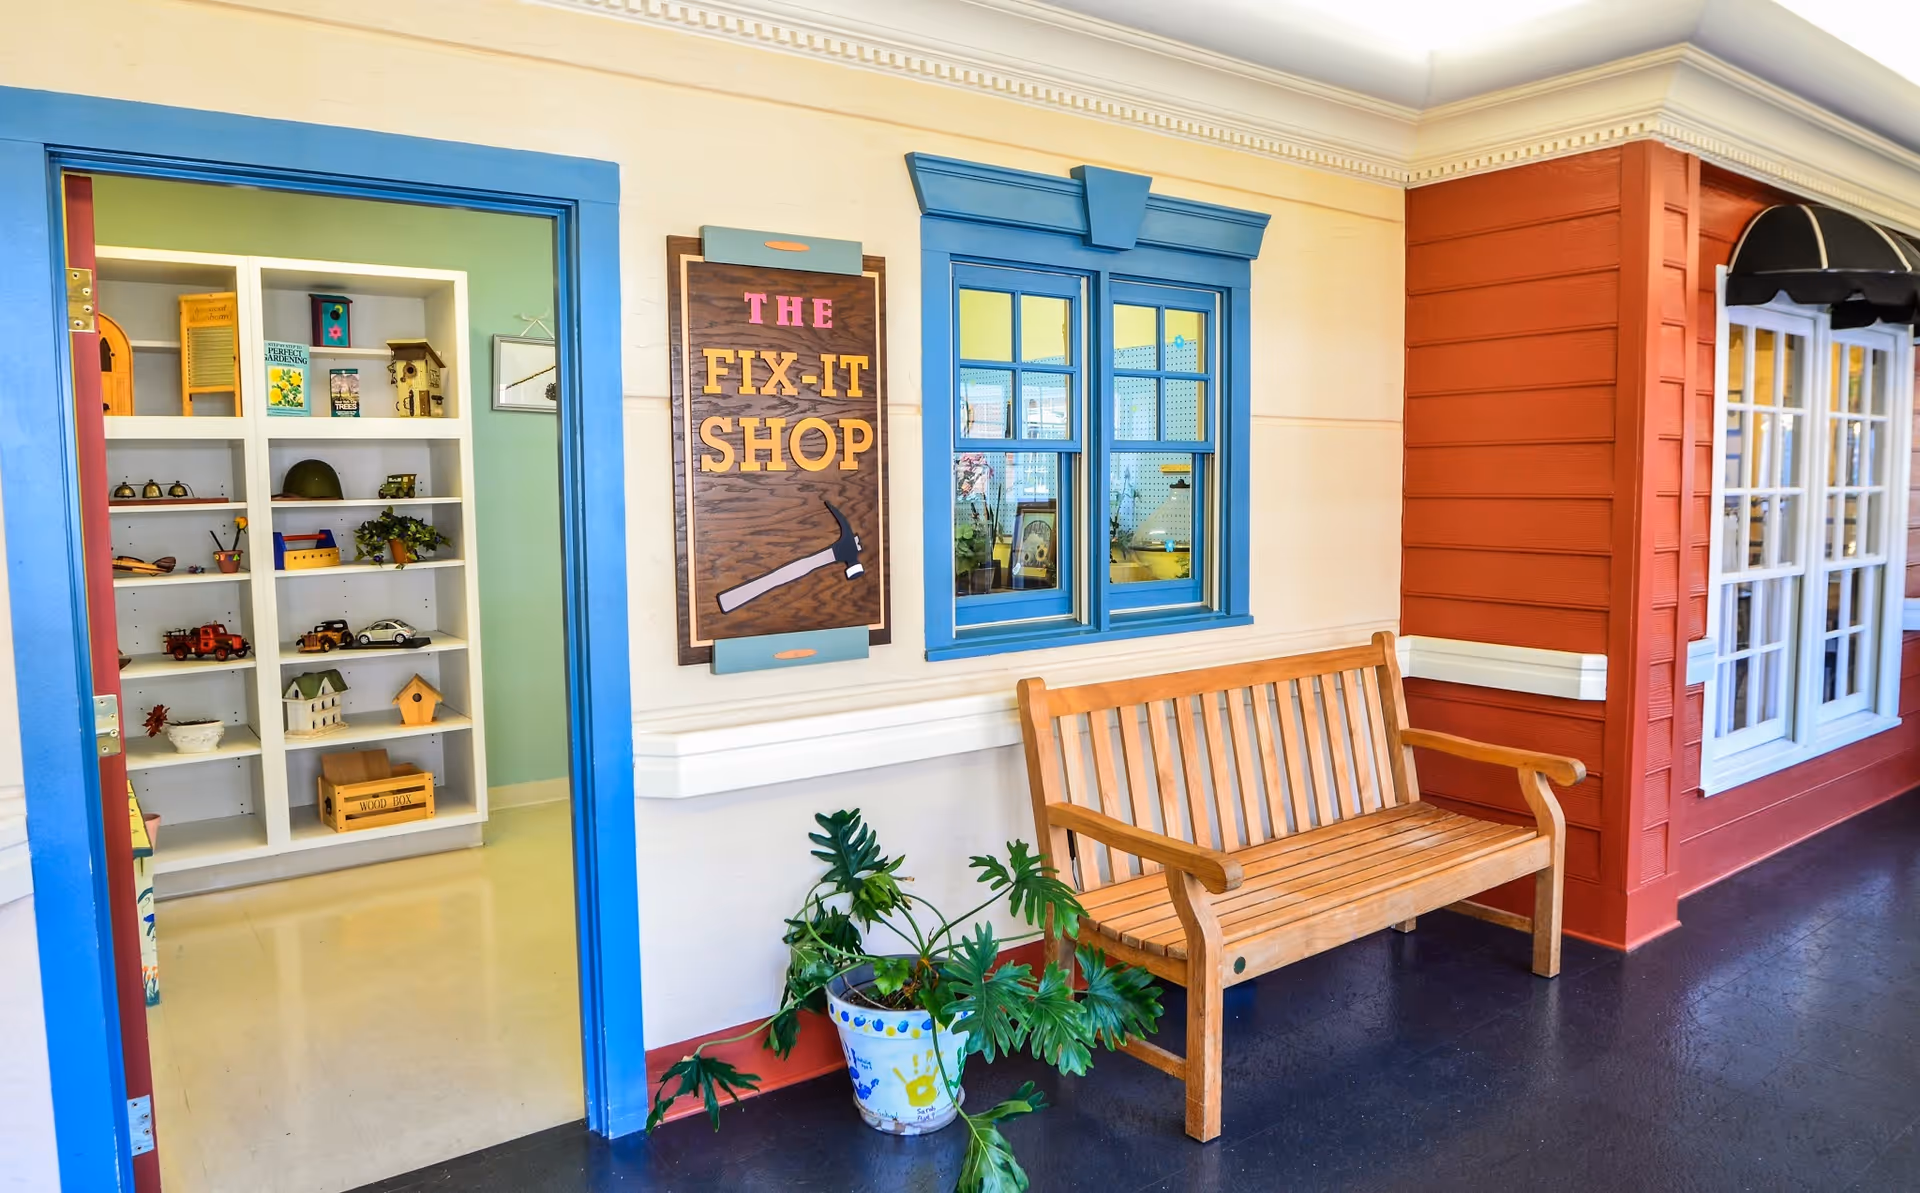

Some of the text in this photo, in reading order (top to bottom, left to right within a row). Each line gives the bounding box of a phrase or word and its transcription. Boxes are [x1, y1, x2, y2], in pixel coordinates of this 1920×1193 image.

[743, 291, 834, 329] THE
[268, 347, 303, 358] PERFECT
[702, 348, 869, 398] FIX-IT
[698, 416, 874, 474] SHOP
[359, 794, 412, 812] WOOD BOX
